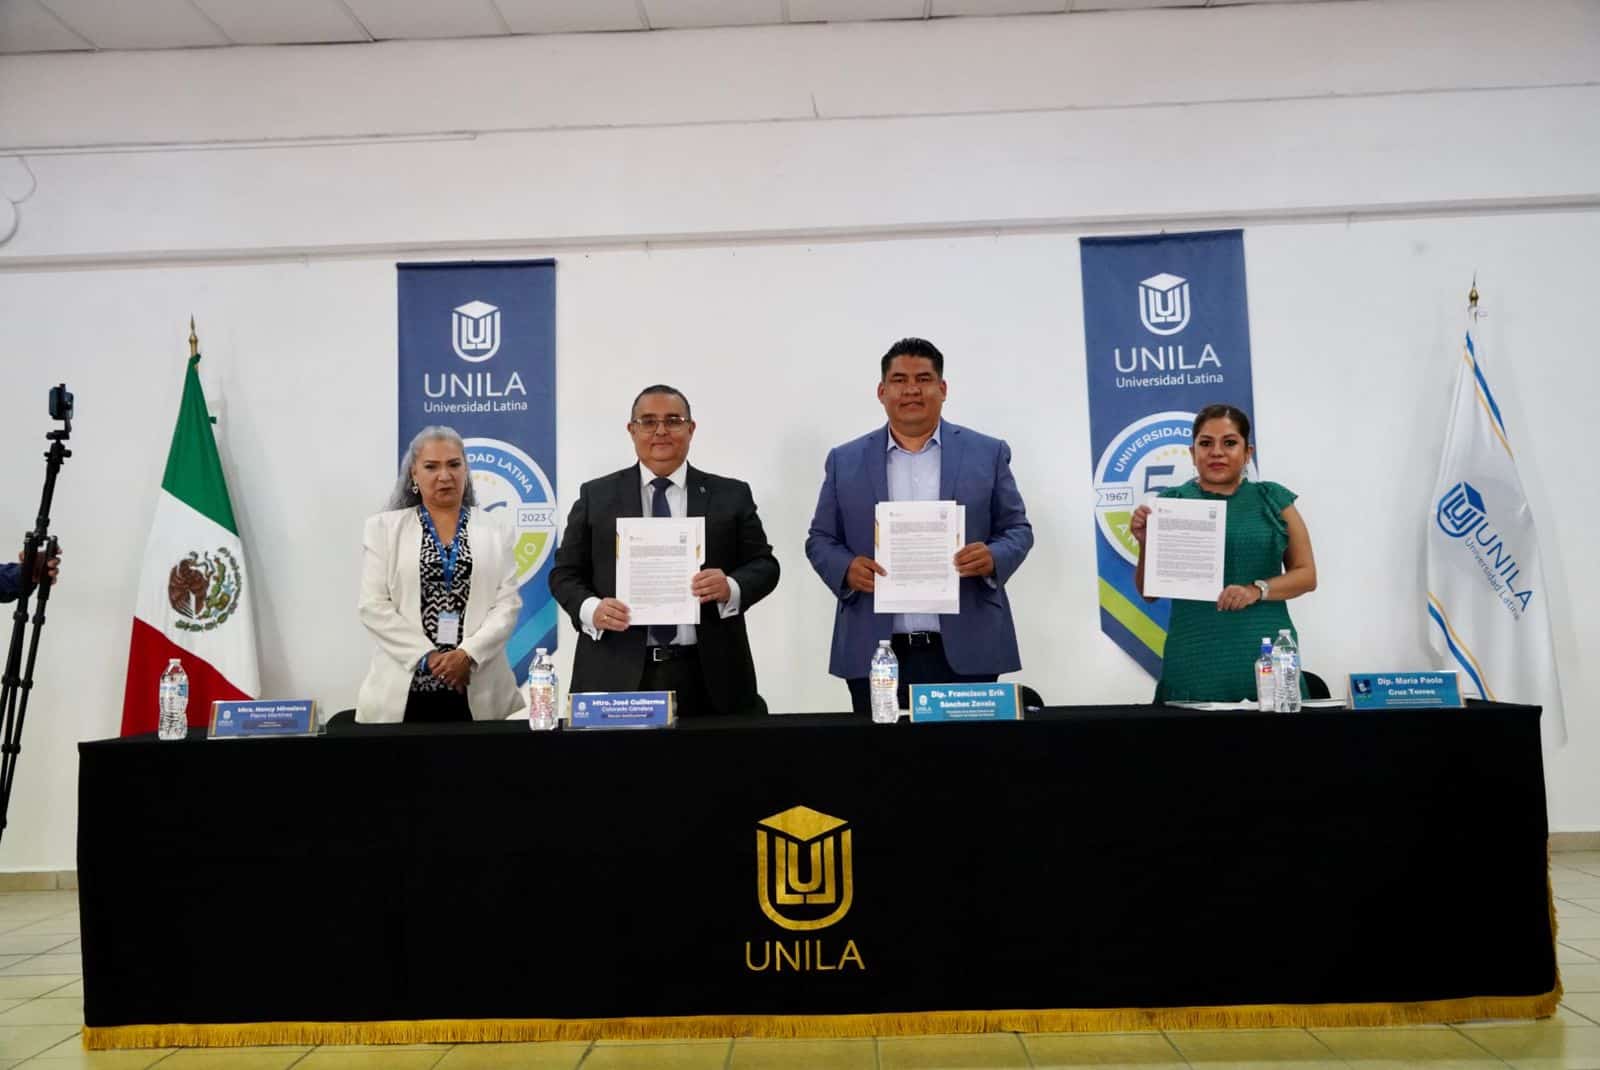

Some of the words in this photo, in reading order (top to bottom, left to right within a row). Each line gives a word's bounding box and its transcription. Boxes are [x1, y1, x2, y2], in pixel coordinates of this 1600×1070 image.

[1114, 343, 1222, 373] UNILA
[424, 371, 527, 398] UNILA
[1115, 373, 1185, 388] Universidad
[1186, 373, 1224, 385] Latina
[423, 400, 491, 413] Universidad
[493, 399, 528, 412] Latina
[1113, 427, 1193, 473] UNIVERSIDAD
[497, 457, 534, 494] LATINA
[1105, 492, 1129, 501] 1967
[521, 513, 547, 523] 2023
[1475, 521, 1533, 612] UNILA
[745, 939, 866, 972] UNILA
